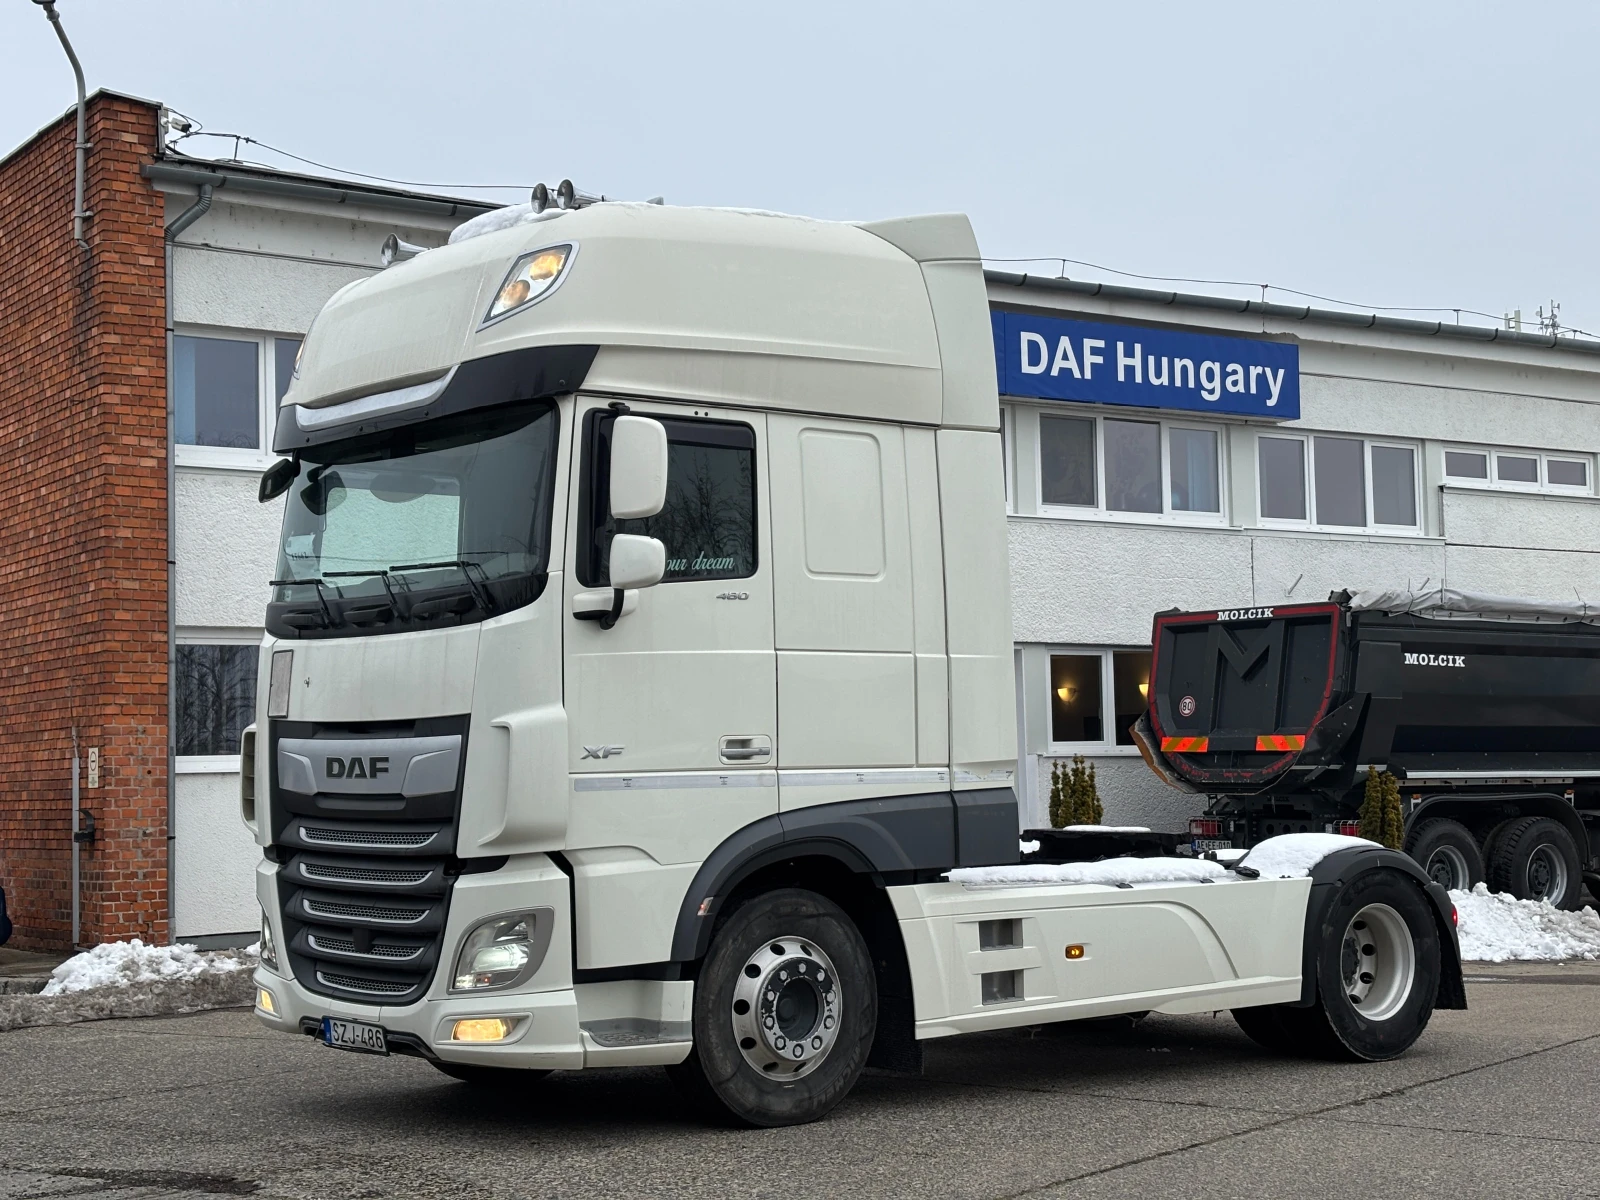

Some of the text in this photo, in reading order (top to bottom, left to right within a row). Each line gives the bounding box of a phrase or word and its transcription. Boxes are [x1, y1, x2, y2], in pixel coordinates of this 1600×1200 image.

[1019, 330, 1285, 407] DAF Hungary
[691, 550, 736, 570] dream
[1217, 608, 1274, 621] MOLCIK
[1403, 652, 1466, 668] MOLCIK
[1183, 701, 1192, 711] 80
[580, 744, 625, 760] XF
[326, 755, 390, 779] DAF
[332, 1022, 384, 1049] SZJ-486
